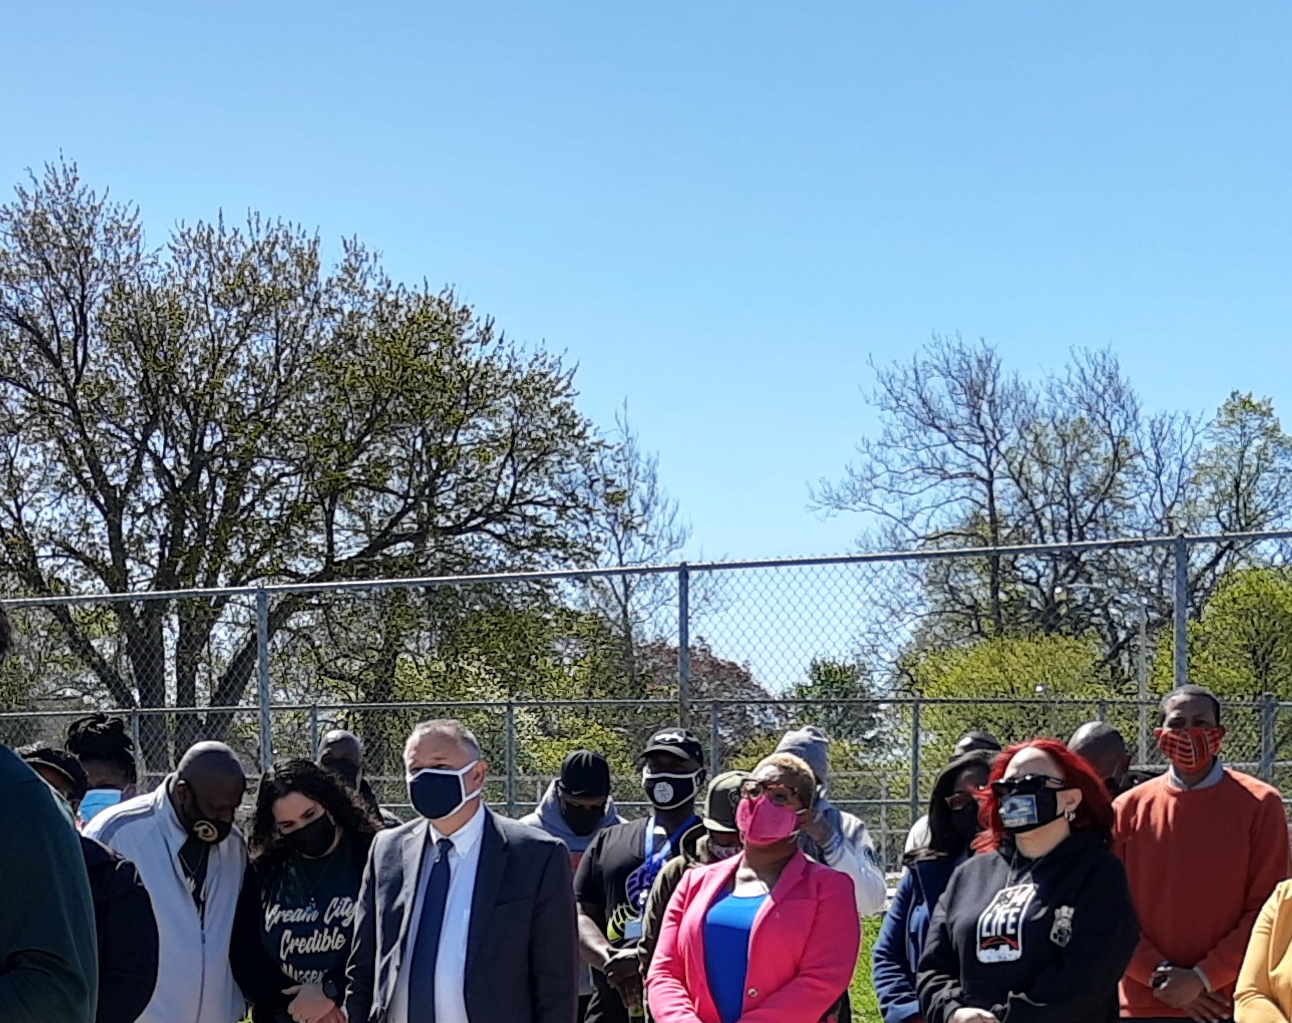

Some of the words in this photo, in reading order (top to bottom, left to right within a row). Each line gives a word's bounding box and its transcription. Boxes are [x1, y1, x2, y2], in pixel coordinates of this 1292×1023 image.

[264, 903, 319, 934] Cream
[323, 896, 358, 928] City
[981, 907, 1021, 938] LIFE
[279, 926, 347, 961] Credible
